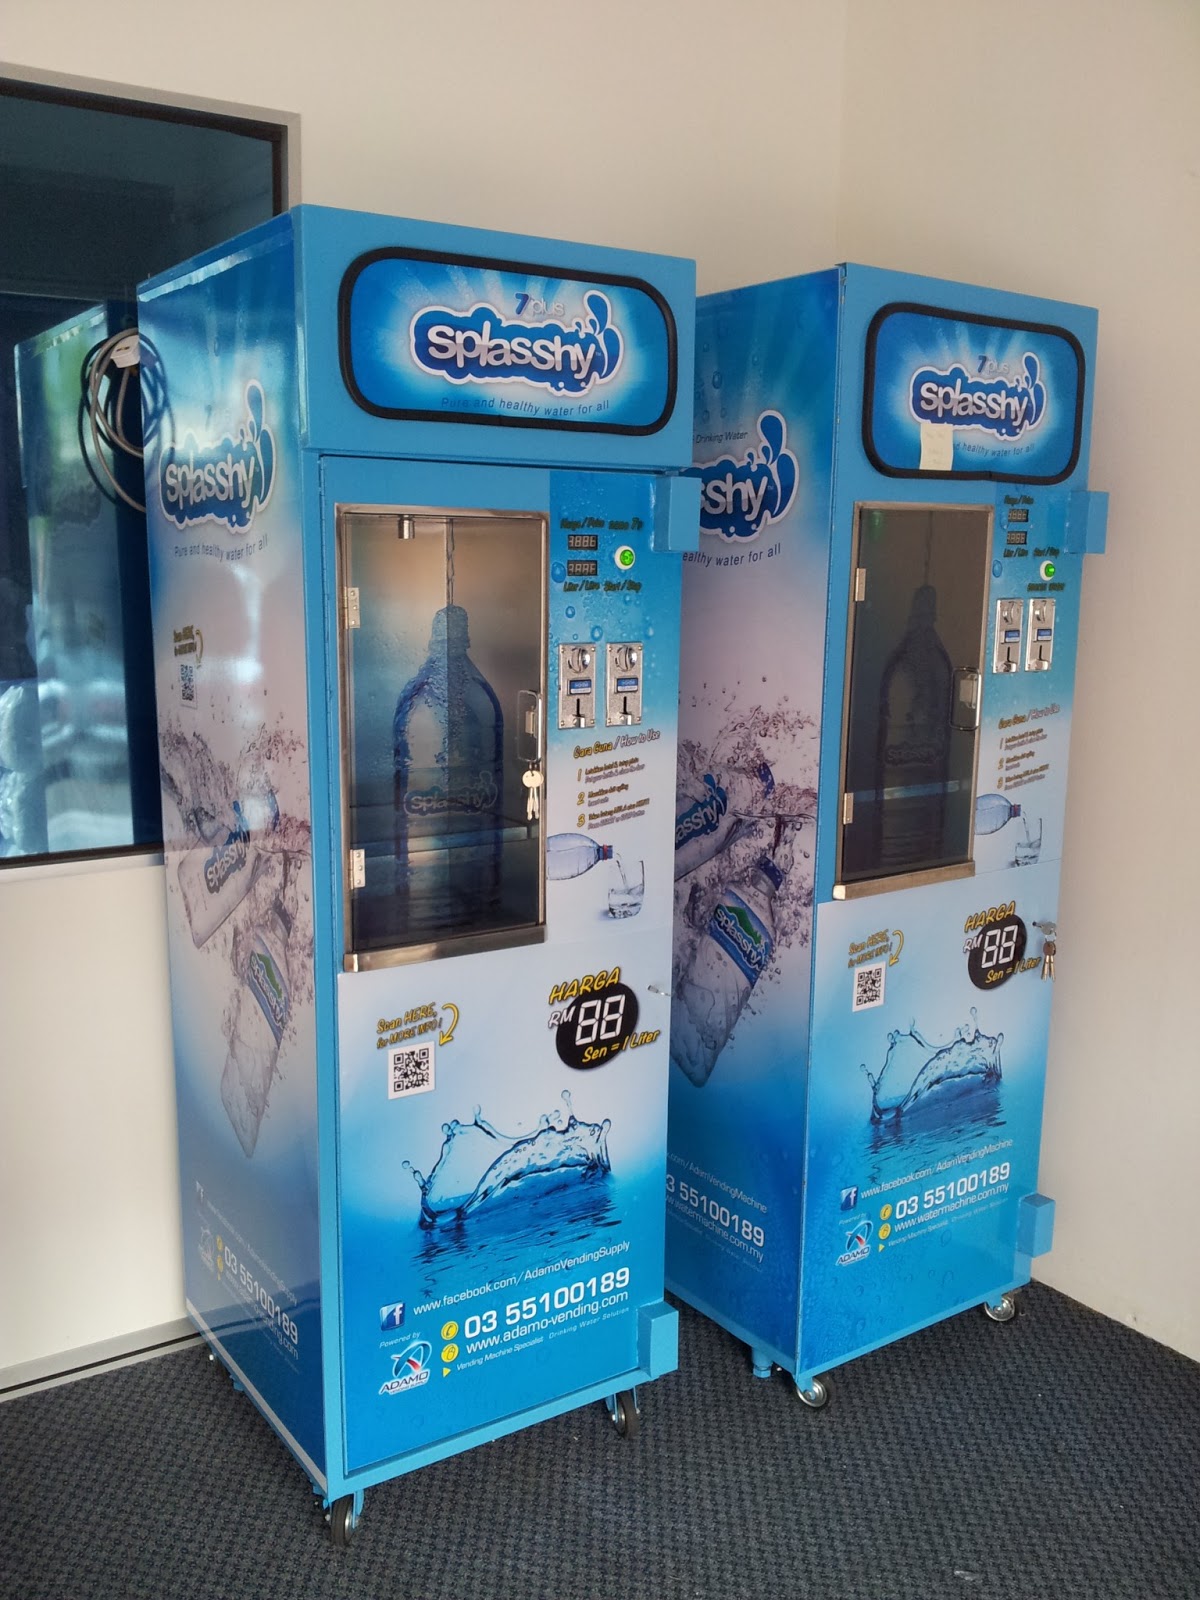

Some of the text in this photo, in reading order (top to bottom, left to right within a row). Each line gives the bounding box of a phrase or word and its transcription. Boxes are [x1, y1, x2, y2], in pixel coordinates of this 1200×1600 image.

[428, 320, 597, 380] splasshy
[441, 397, 610, 417] Pure and healthy water for all
[920, 378, 1029, 427] splasshy
[696, 430, 748, 444] Drinking Water
[962, 442, 989, 456] healthy
[991, 447, 1011, 457] water
[165, 449, 256, 509] splasshy
[201, 543, 224, 563] healthy
[226, 546, 244, 561] water
[245, 543, 256, 557] for
[258, 532, 269, 551] all
[682, 542, 781, 568] ealthy water for all
[577, 792, 585, 806] 2
[577, 814, 586, 827] 3
[676, 802, 718, 844] asshy
[965, 900, 1015, 932] HARGA
[716, 907, 760, 965] splasshy
[963, 933, 983, 953] RM
[549, 967, 620, 1004] HARGA
[985, 968, 1004, 984] Sen
[1019, 956, 1042, 972] Liter
[376, 1017, 403, 1034] Scan
[548, 1004, 576, 1028] RM
[582, 1044, 607, 1063] Sen
[630, 1029, 661, 1049] Liter
[667, 1153, 768, 1213] .com/AdamVendingMachine
[895, 1162, 1010, 1220] 03 55100189
[666, 1174, 675, 1193] 3
[679, 1181, 765, 1247] 55100189
[894, 1182, 1009, 1233] www.watermachine.com.my
[837, 1246, 870, 1265] ADAMO
[413, 1240, 631, 1316] www.facebook.com/AdamoVendingSupply
[224, 1246, 237, 1275] 03
[239, 1263, 299, 1345] 55100189
[464, 1266, 631, 1340] 03 55100189
[466, 1290, 628, 1354] www.adamo-vending.com
[549, 1324, 578, 1340] Drinking
[579, 1317, 601, 1329] Water
[379, 1332, 411, 1349] Powered
[456, 1336, 544, 1371] Vending Machine Specialist
[380, 1371, 429, 1394] ADAMO
